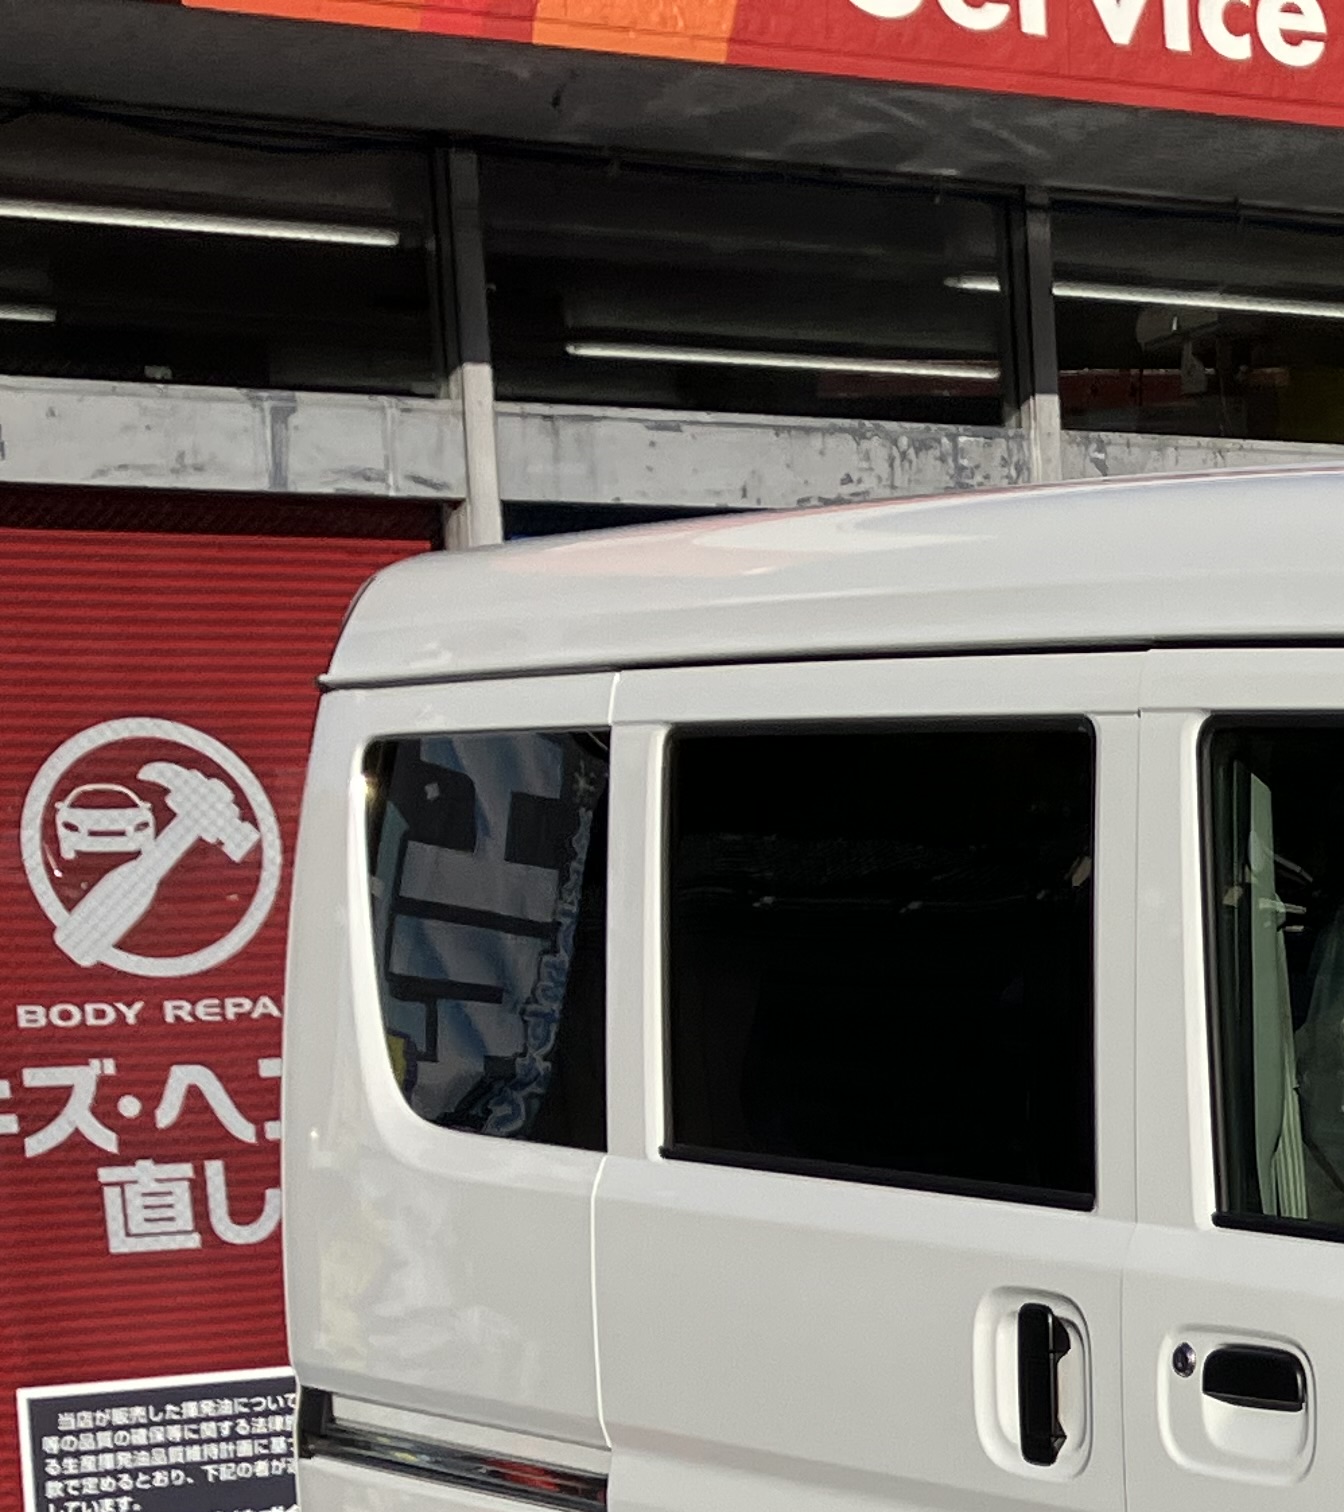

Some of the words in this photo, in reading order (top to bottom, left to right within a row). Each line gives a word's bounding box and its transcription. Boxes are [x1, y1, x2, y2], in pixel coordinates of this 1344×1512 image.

[16, 1001, 144, 1028] BODY
[163, 995, 282, 1024] REPA
[97, 1158, 282, 1255] 直し
